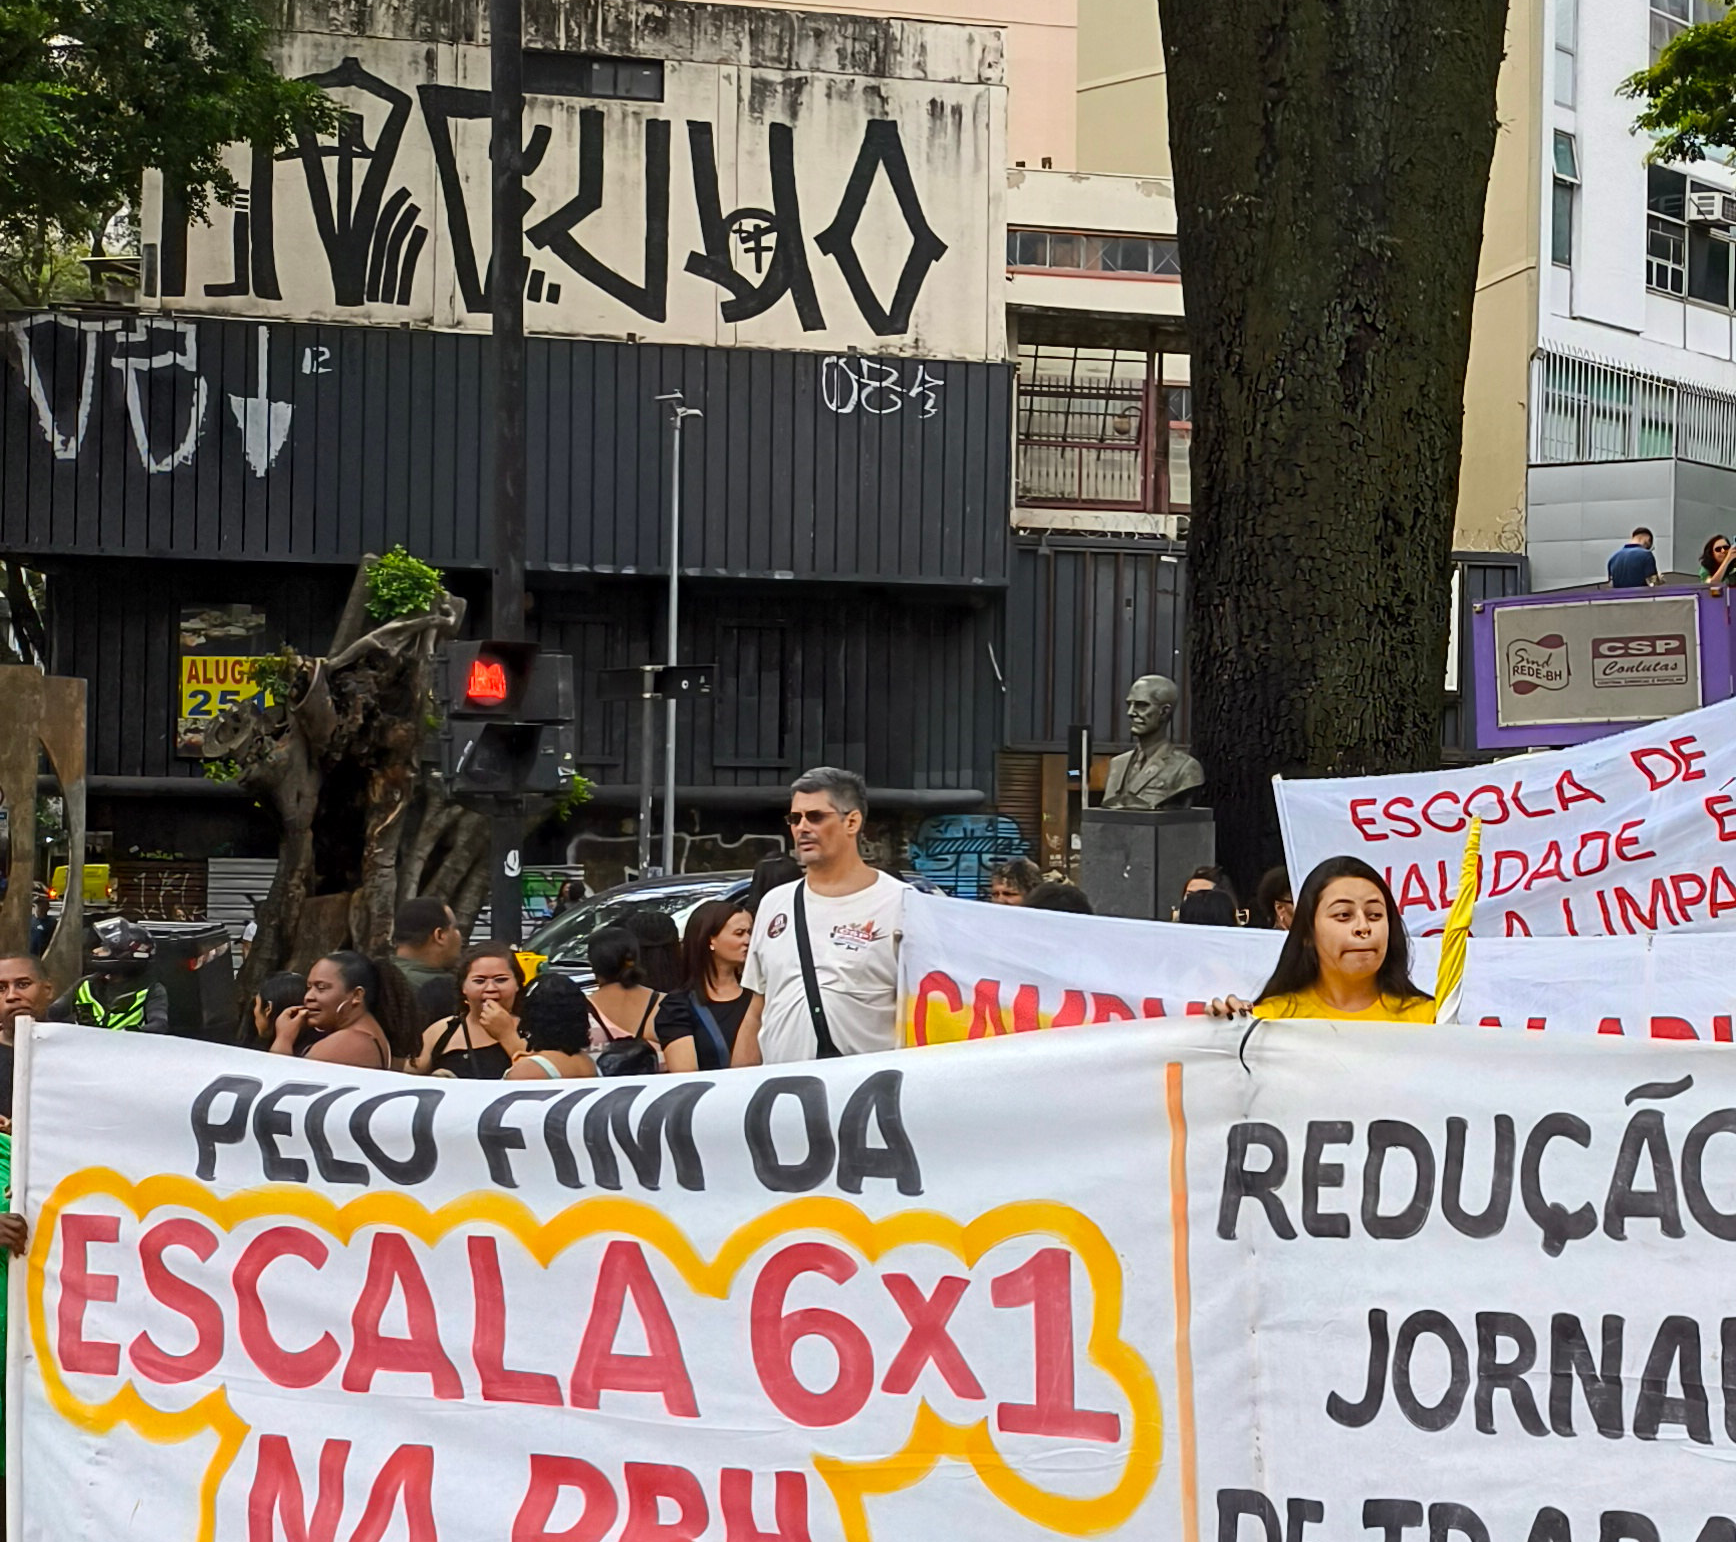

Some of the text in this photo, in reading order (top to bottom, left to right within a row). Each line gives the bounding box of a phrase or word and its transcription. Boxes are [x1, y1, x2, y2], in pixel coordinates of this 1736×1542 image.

[1515, 647, 1553, 669] Sind
[1599, 639, 1680, 656] CSP
[1512, 665, 1563, 681] REDE-BH
[1602, 660, 1678, 676] Conlutas
[1350, 735, 1707, 842] ESCOLA DE
[191, 1074, 446, 1186] PELO
[477, 1081, 715, 1191] FIM
[57, 1213, 700, 1419] ESCALA
